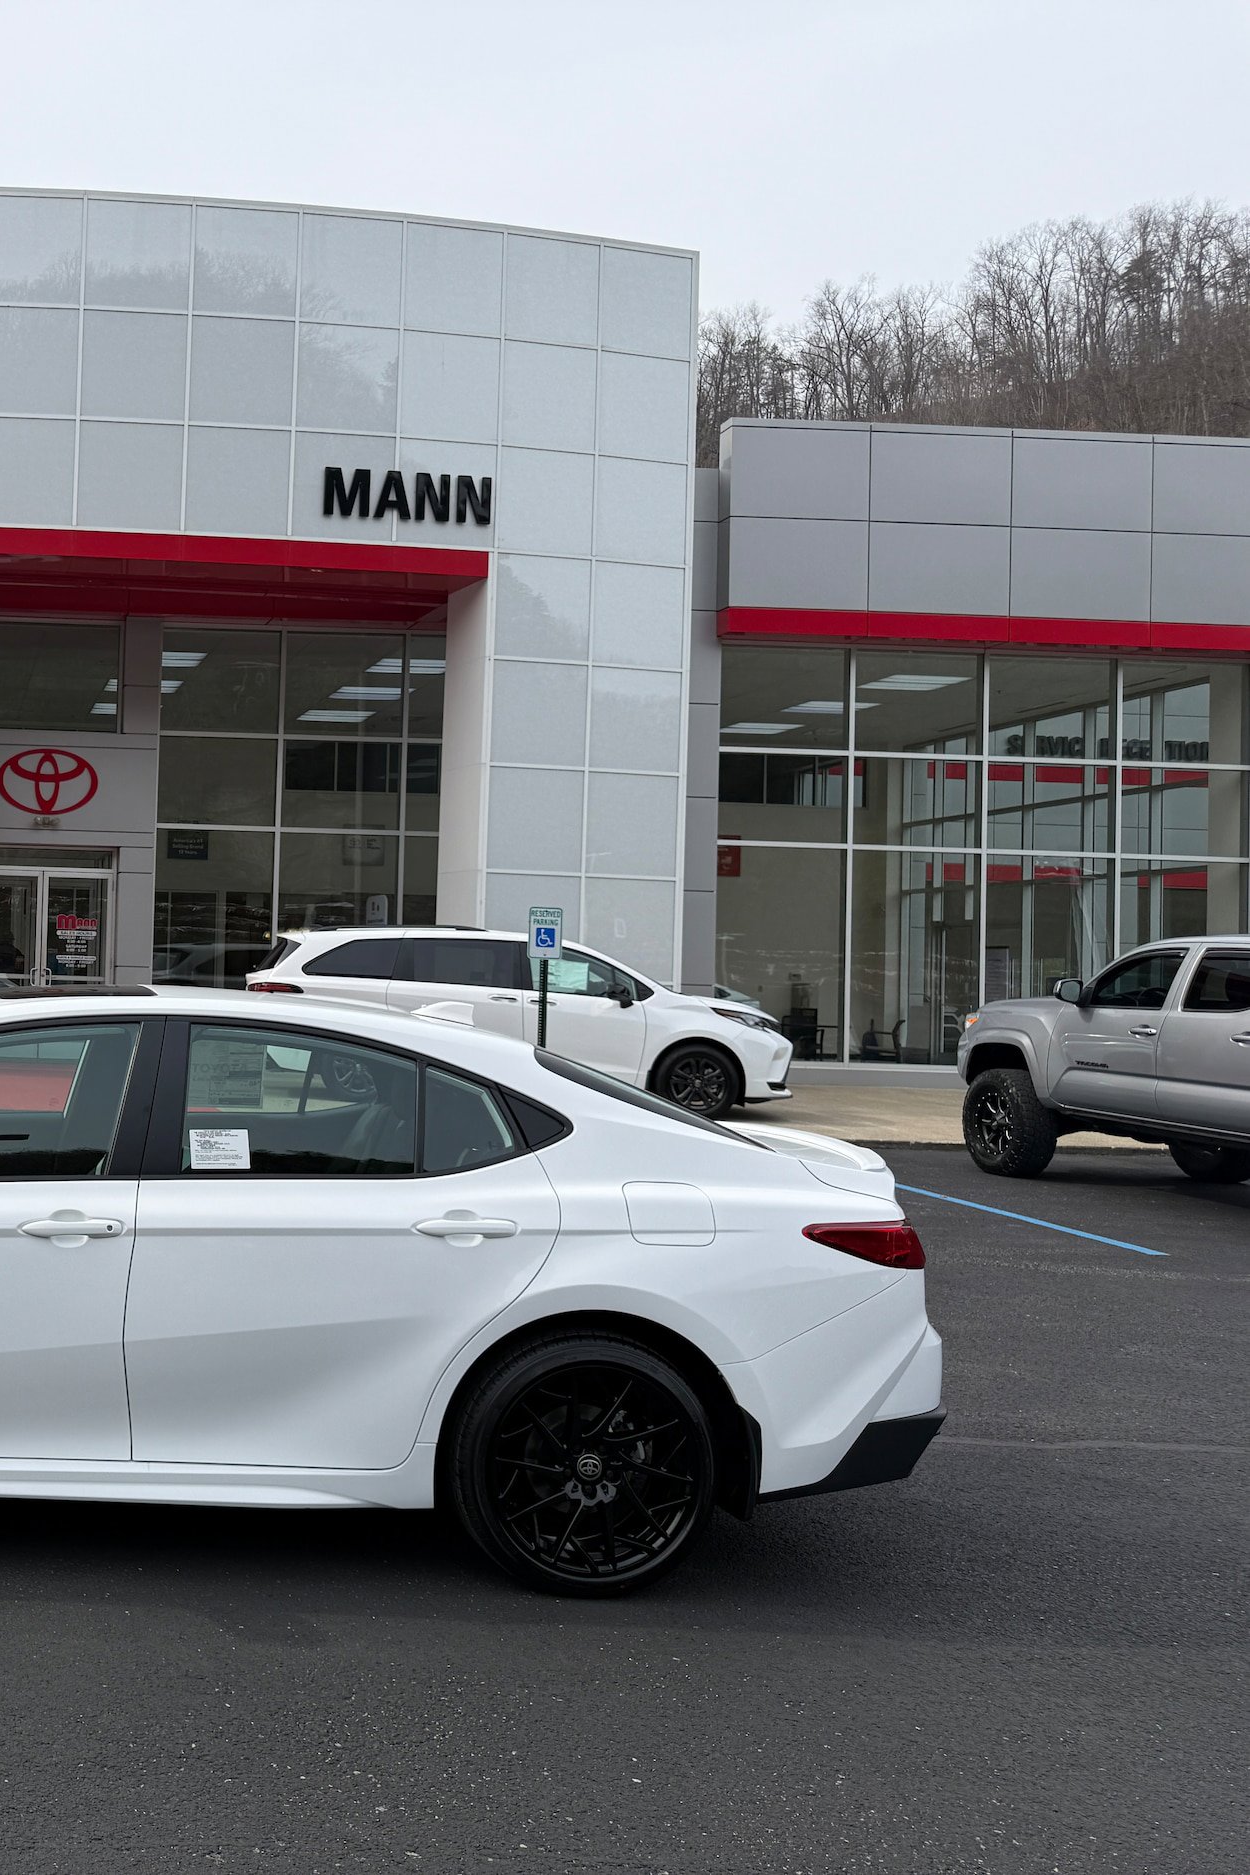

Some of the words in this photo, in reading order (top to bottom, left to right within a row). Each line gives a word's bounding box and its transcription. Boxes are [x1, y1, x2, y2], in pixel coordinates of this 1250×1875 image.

[323, 466, 492, 525] MANN
[531, 910, 561, 918] RESERVED
[533, 918, 559, 926] PARKING
